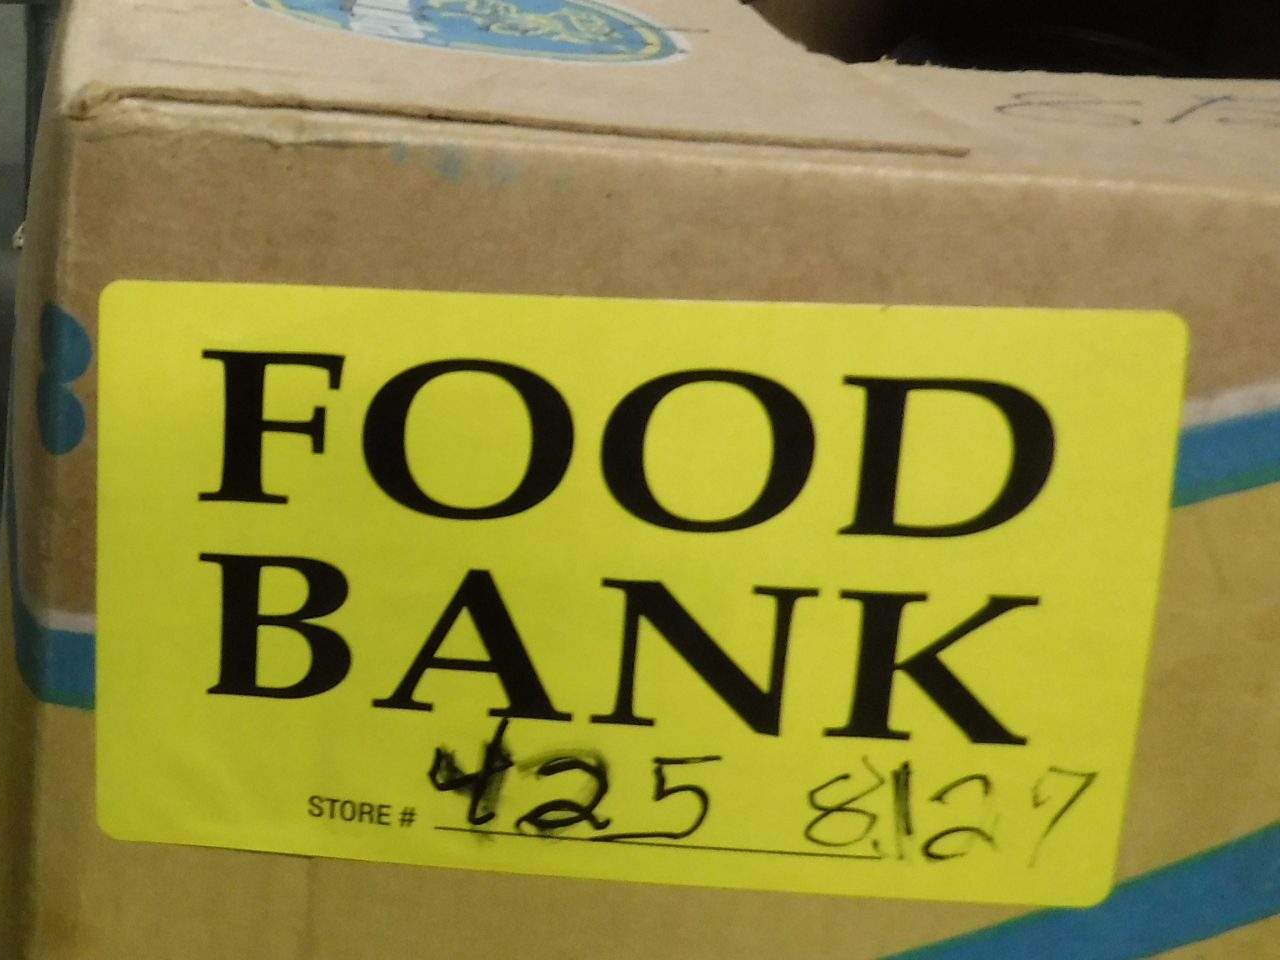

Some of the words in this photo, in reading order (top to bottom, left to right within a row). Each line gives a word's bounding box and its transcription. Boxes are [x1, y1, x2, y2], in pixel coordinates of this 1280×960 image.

[198, 350, 1055, 538] FOOD
[198, 552, 1040, 746] BANK
[308, 795, 392, 826] STORE
[399, 807, 416, 827] #
[428, 717, 723, 842] 425
